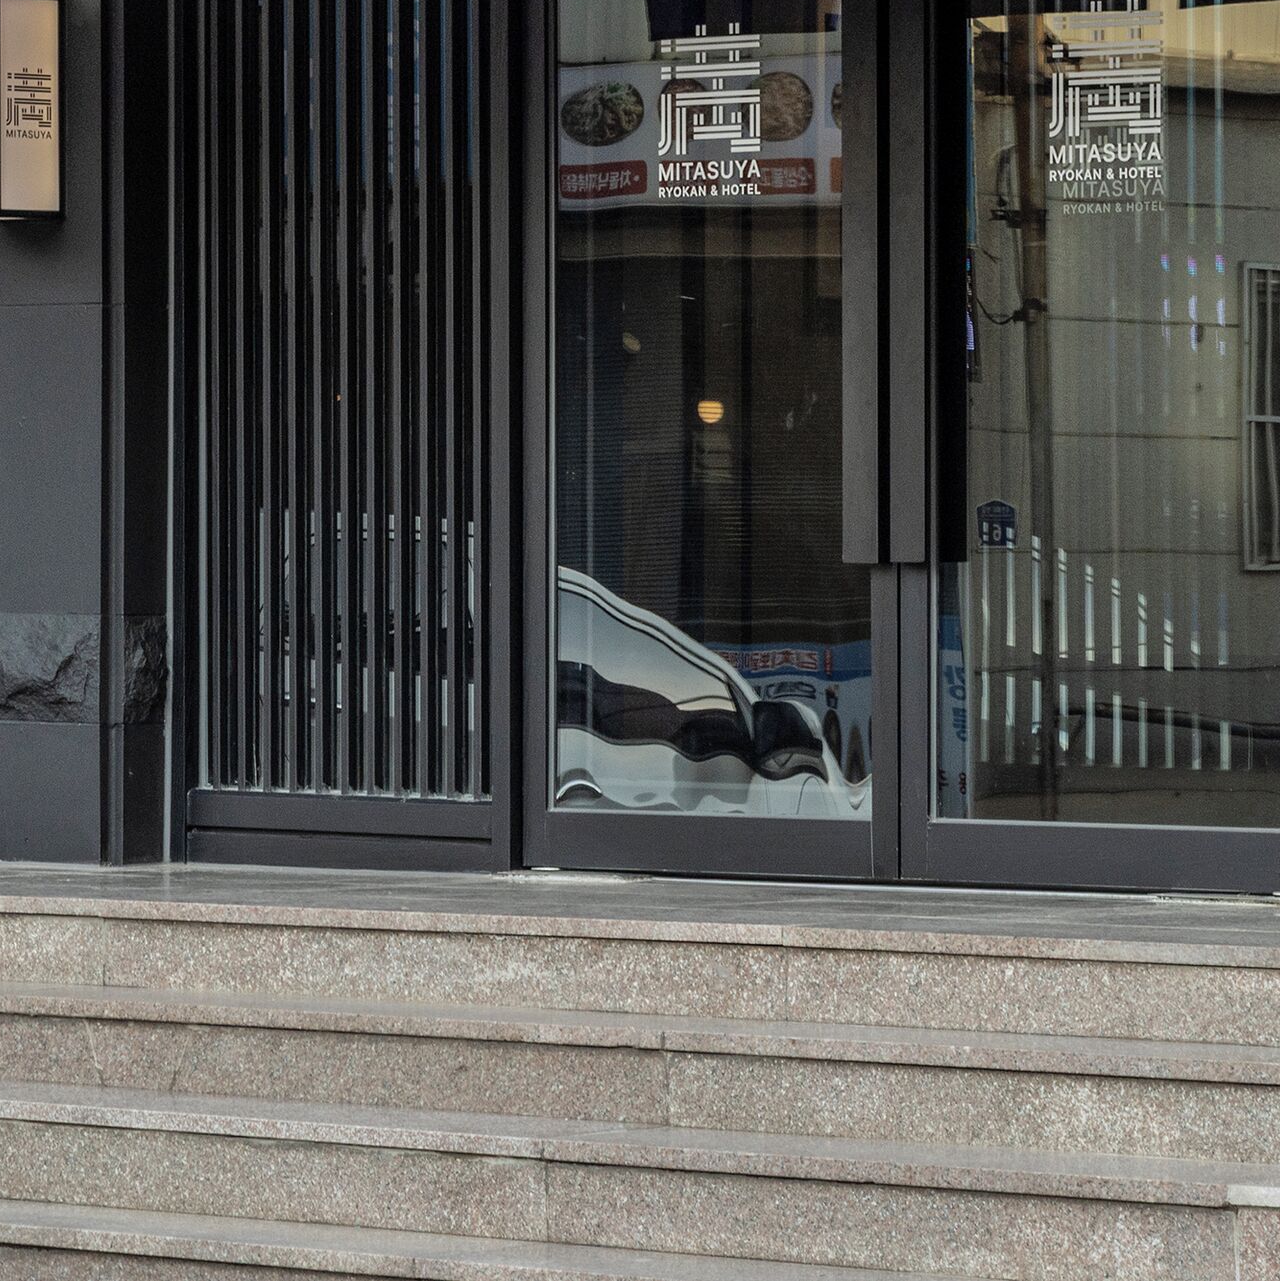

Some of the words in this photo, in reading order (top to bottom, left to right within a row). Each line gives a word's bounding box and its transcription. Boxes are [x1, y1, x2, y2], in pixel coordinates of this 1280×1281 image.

[5, 129, 52, 140] MITASUYA
[1049, 142, 1162, 164] MITASUYA
[658, 159, 761, 182] MITASUYA
[1049, 168, 1101, 182] RYOKAN
[1106, 168, 1114, 180] &
[1118, 166, 1162, 179] HOTEL
[658, 185, 706, 199] RYOKAN
[710, 185, 718, 196] &
[722, 183, 761, 196] HOTEL
[1062, 178, 1165, 199] MITASUYA
[1063, 201, 1111, 215] RYOKAN
[1126, 200, 1165, 213] HOTEL
